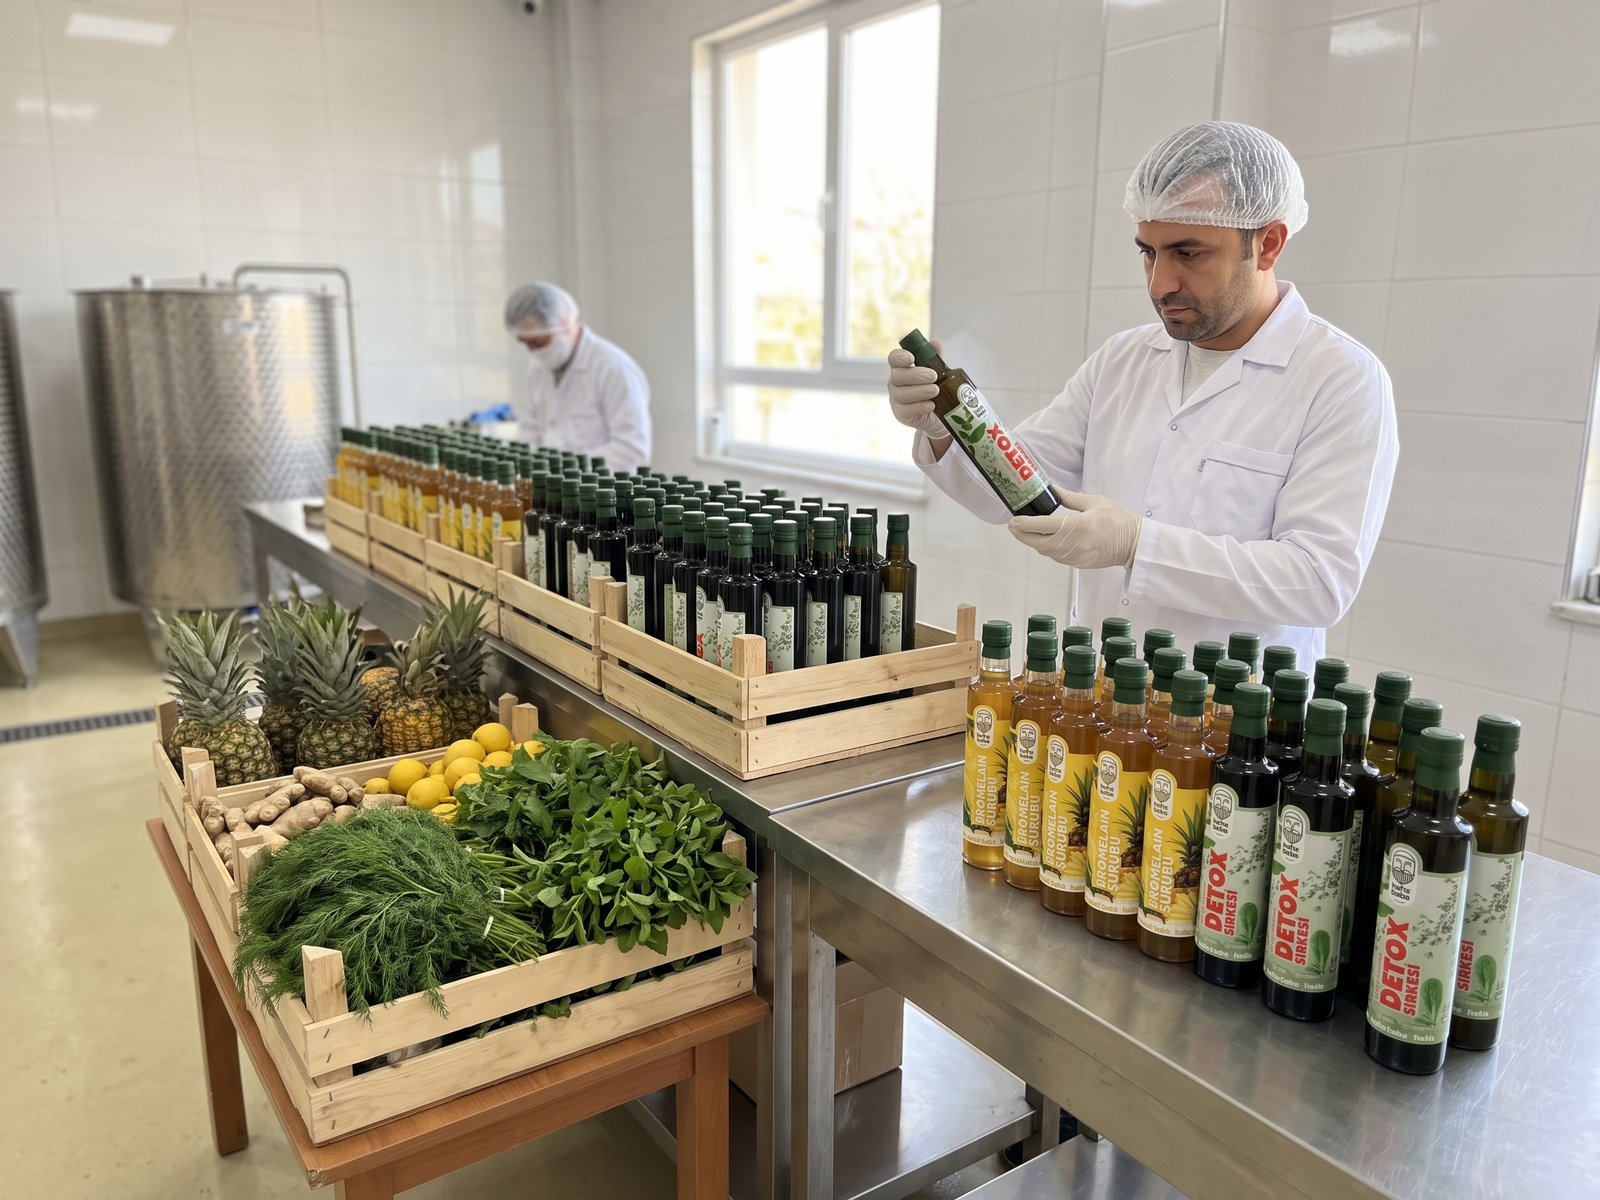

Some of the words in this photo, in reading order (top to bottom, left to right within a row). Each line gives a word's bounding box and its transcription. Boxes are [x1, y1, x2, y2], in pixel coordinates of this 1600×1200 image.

[986, 422, 1034, 481] DETOX
[1204, 848, 1228, 933] DETOX
[1274, 872, 1299, 962] DETOX
[1380, 915, 1409, 1012] DETOX
